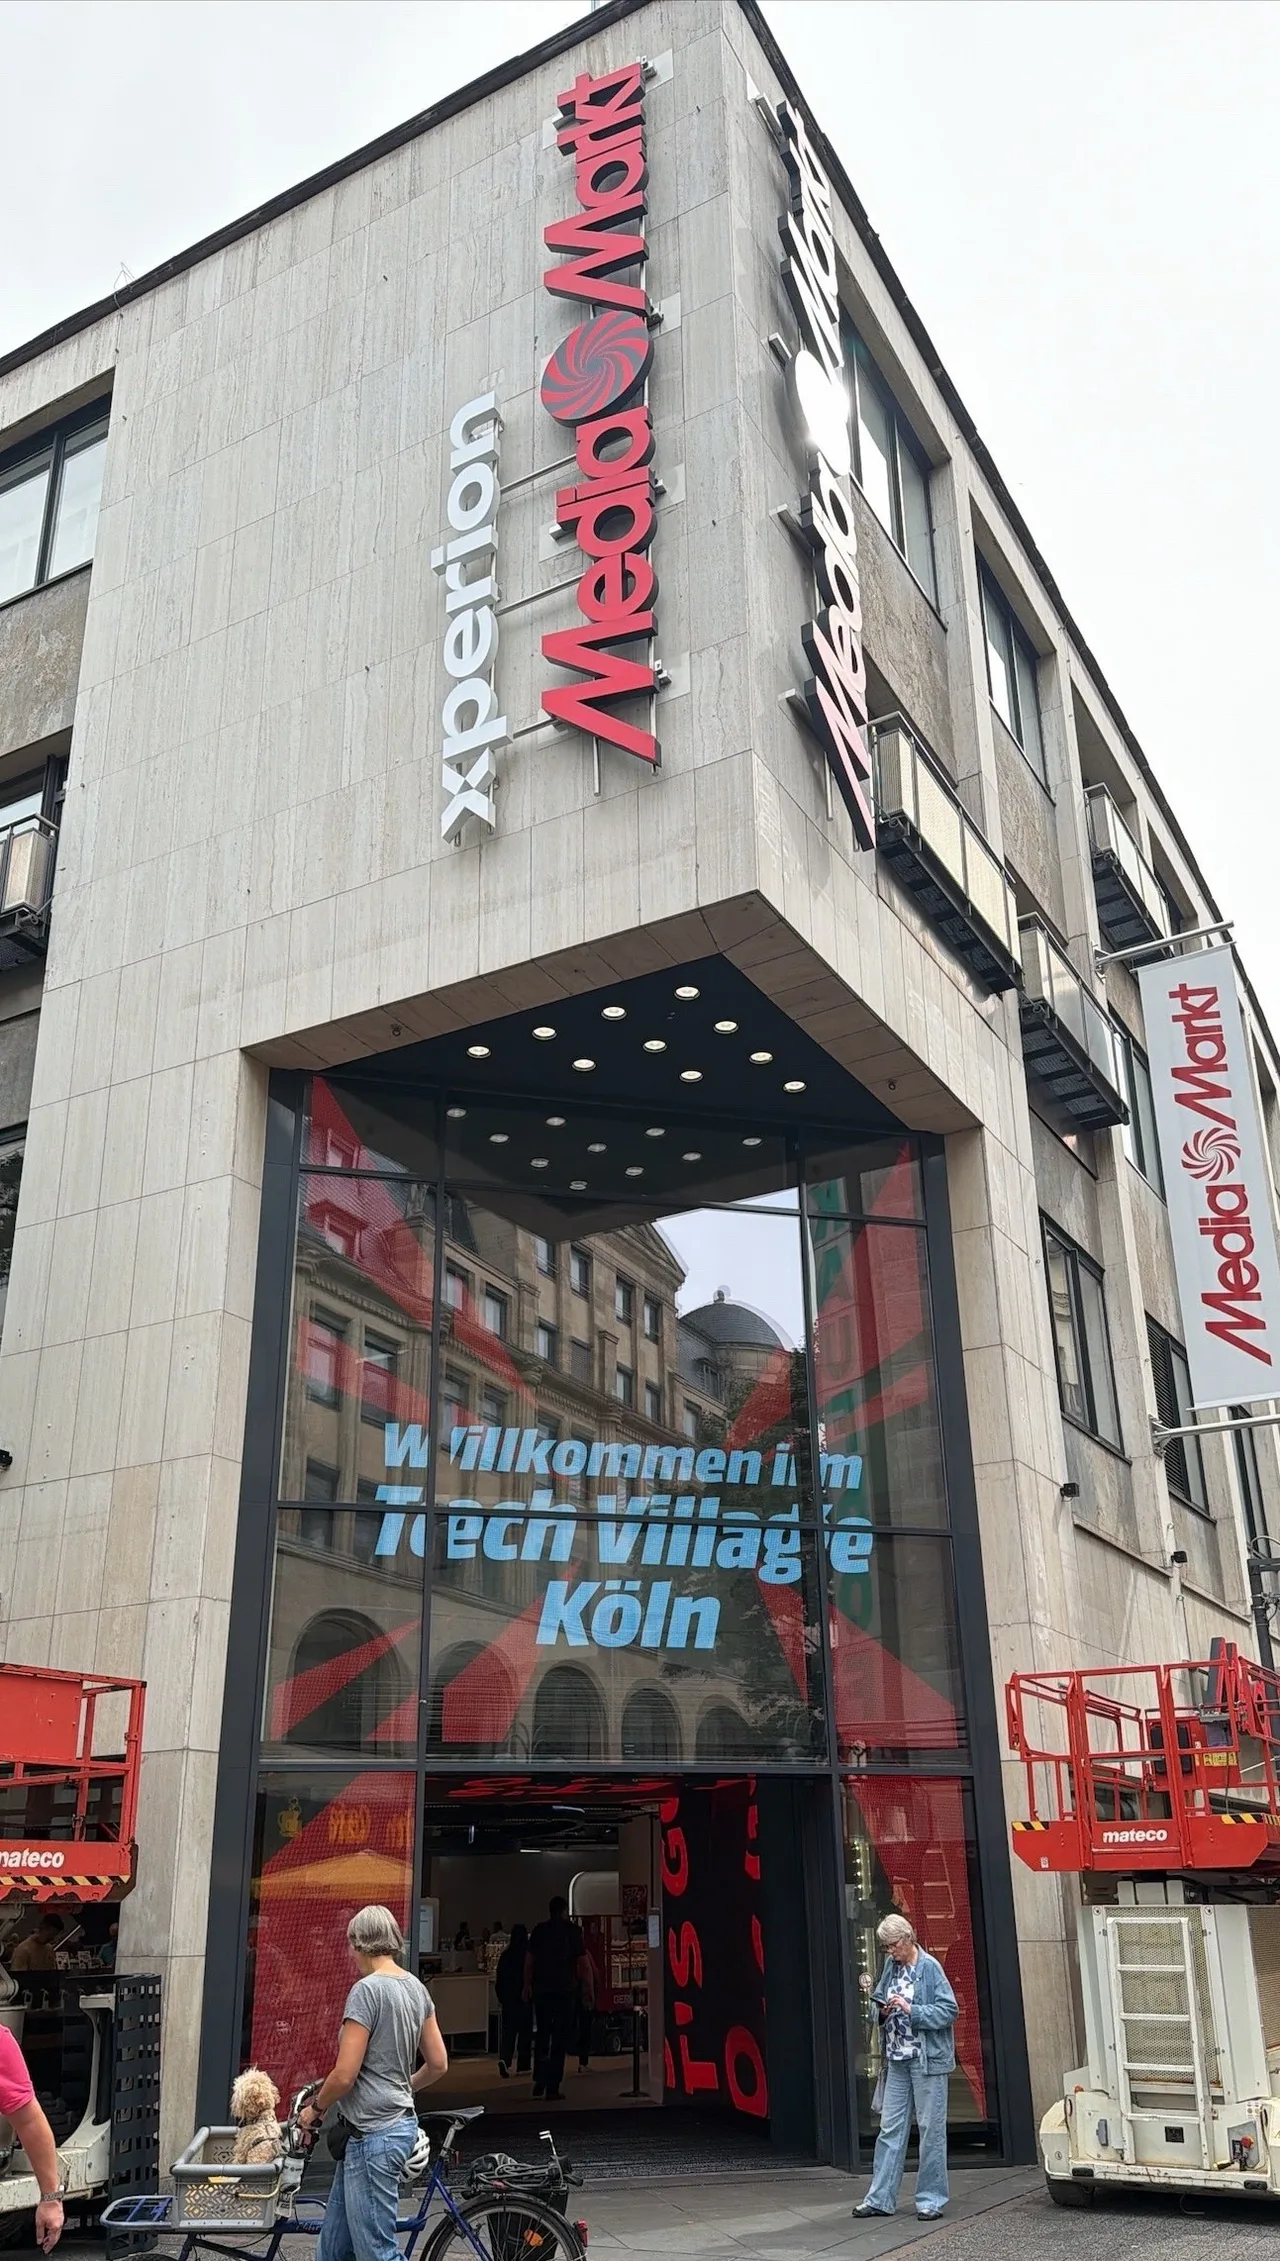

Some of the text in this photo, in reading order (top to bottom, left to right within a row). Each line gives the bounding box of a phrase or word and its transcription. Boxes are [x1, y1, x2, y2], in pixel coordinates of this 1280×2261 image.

[541, 62, 660, 767] Media Markt
[431, 391, 512, 843] xperion
[1168, 983, 1273, 1367] Media Markt
[384, 1422, 762, 1486] Willkommen
[374, 1484, 874, 1584] Tech Village
[536, 1580, 720, 1649] Köln
[1102, 1828, 1168, 1843] mateco
